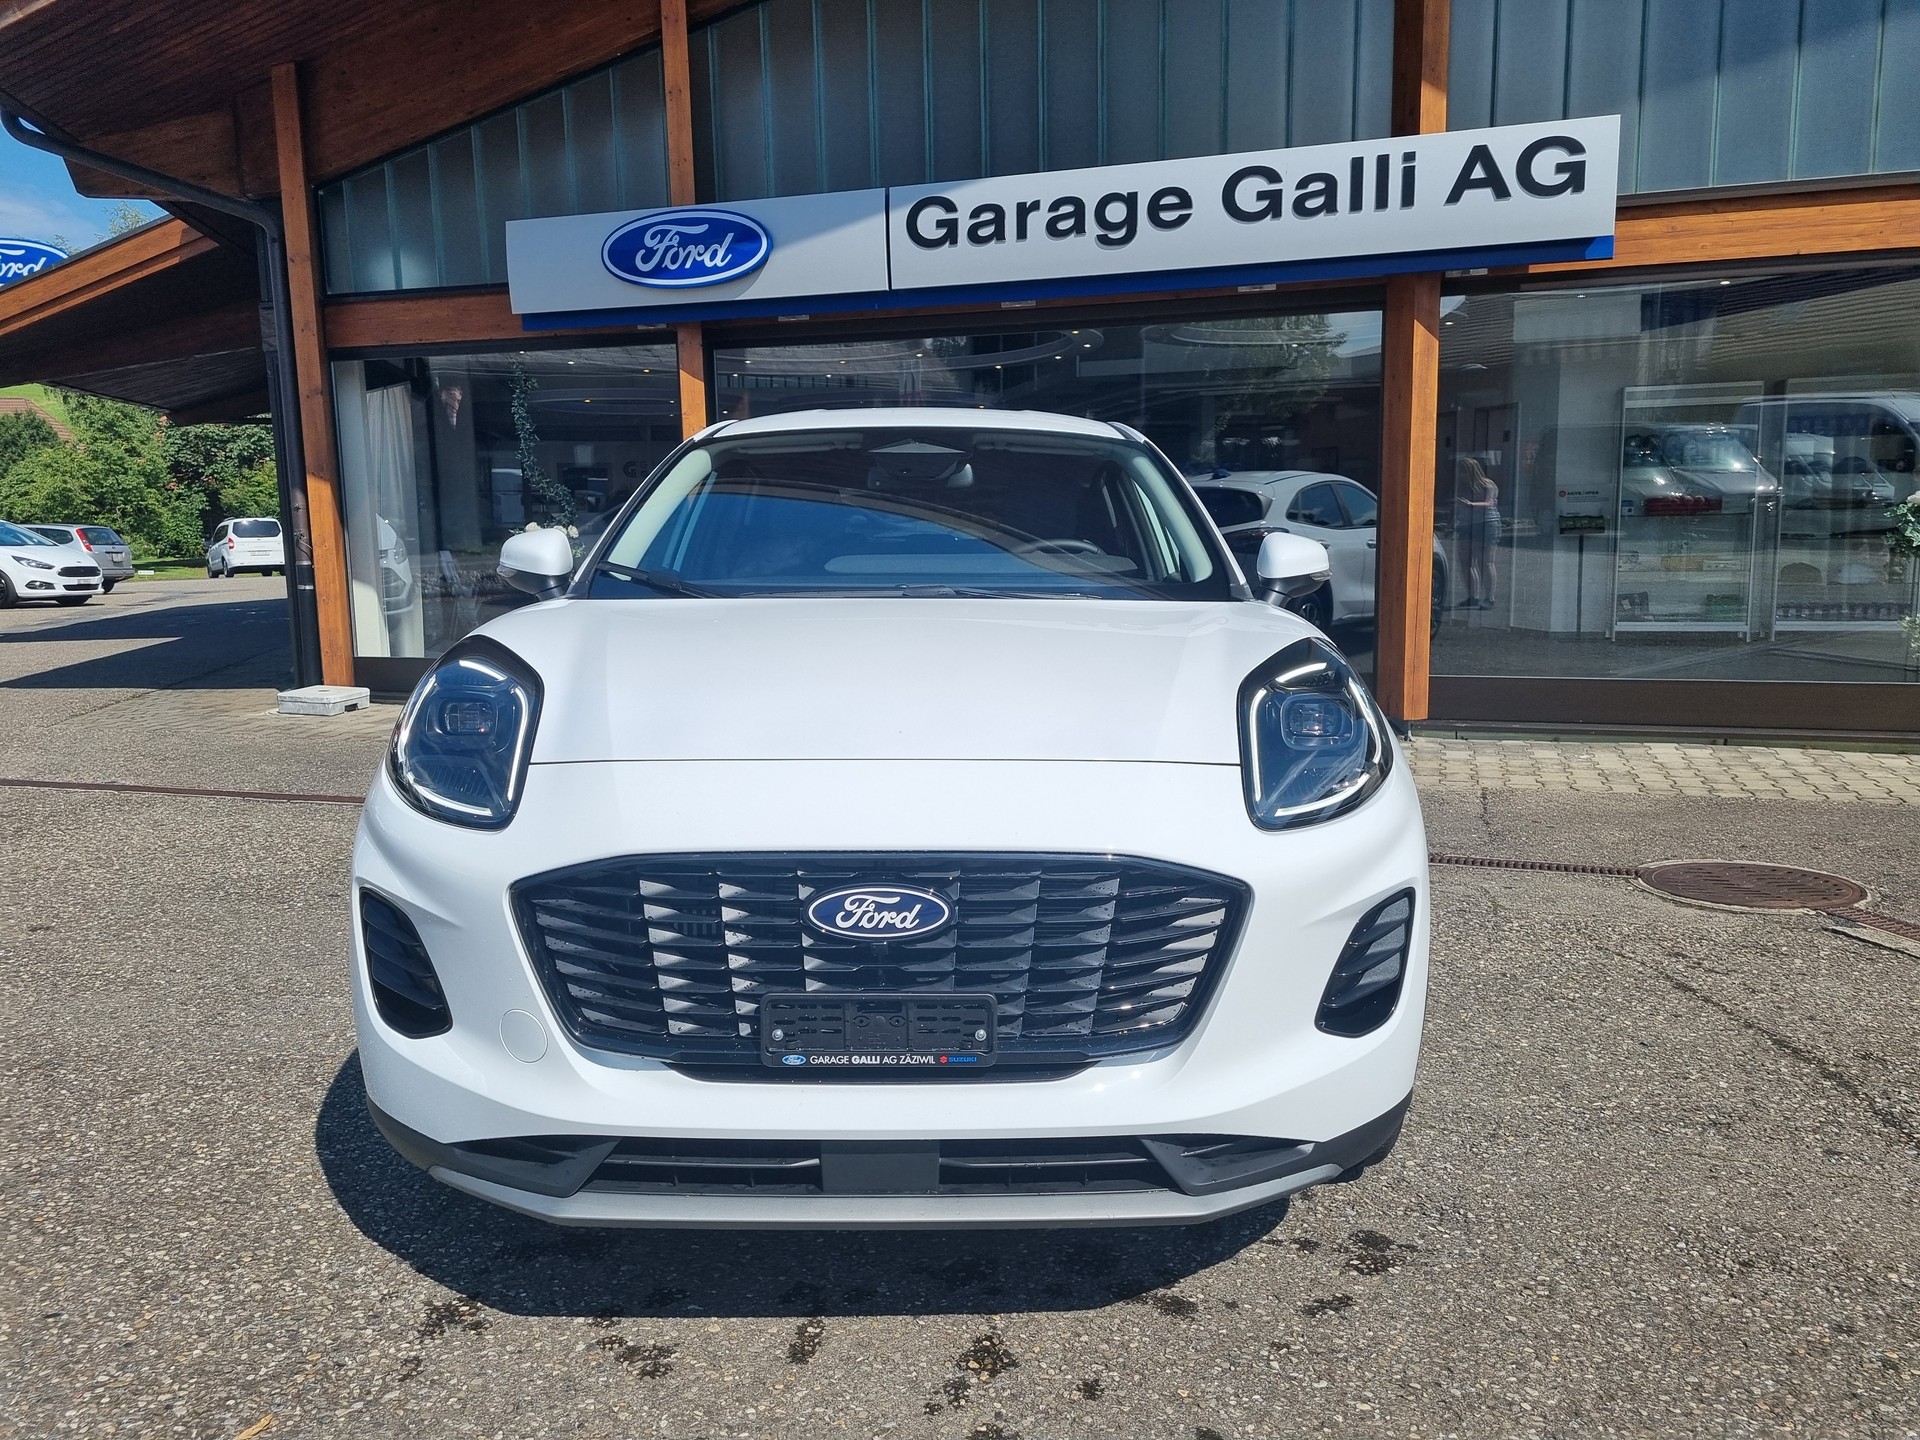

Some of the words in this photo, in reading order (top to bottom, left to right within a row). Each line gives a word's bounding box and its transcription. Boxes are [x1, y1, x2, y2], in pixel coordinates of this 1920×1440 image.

[906, 186, 1193, 250] Garage
[1222, 151, 1416, 223] Galli
[1444, 135, 1587, 206] AG
[635, 223, 735, 272] Ford
[835, 894, 922, 929] Ford
[810, 1055, 849, 1065] GARAGE
[851, 1055, 880, 1065] GALLI
[882, 1055, 897, 1065] AG
[899, 1053, 936, 1064] ZÄZIWIL
